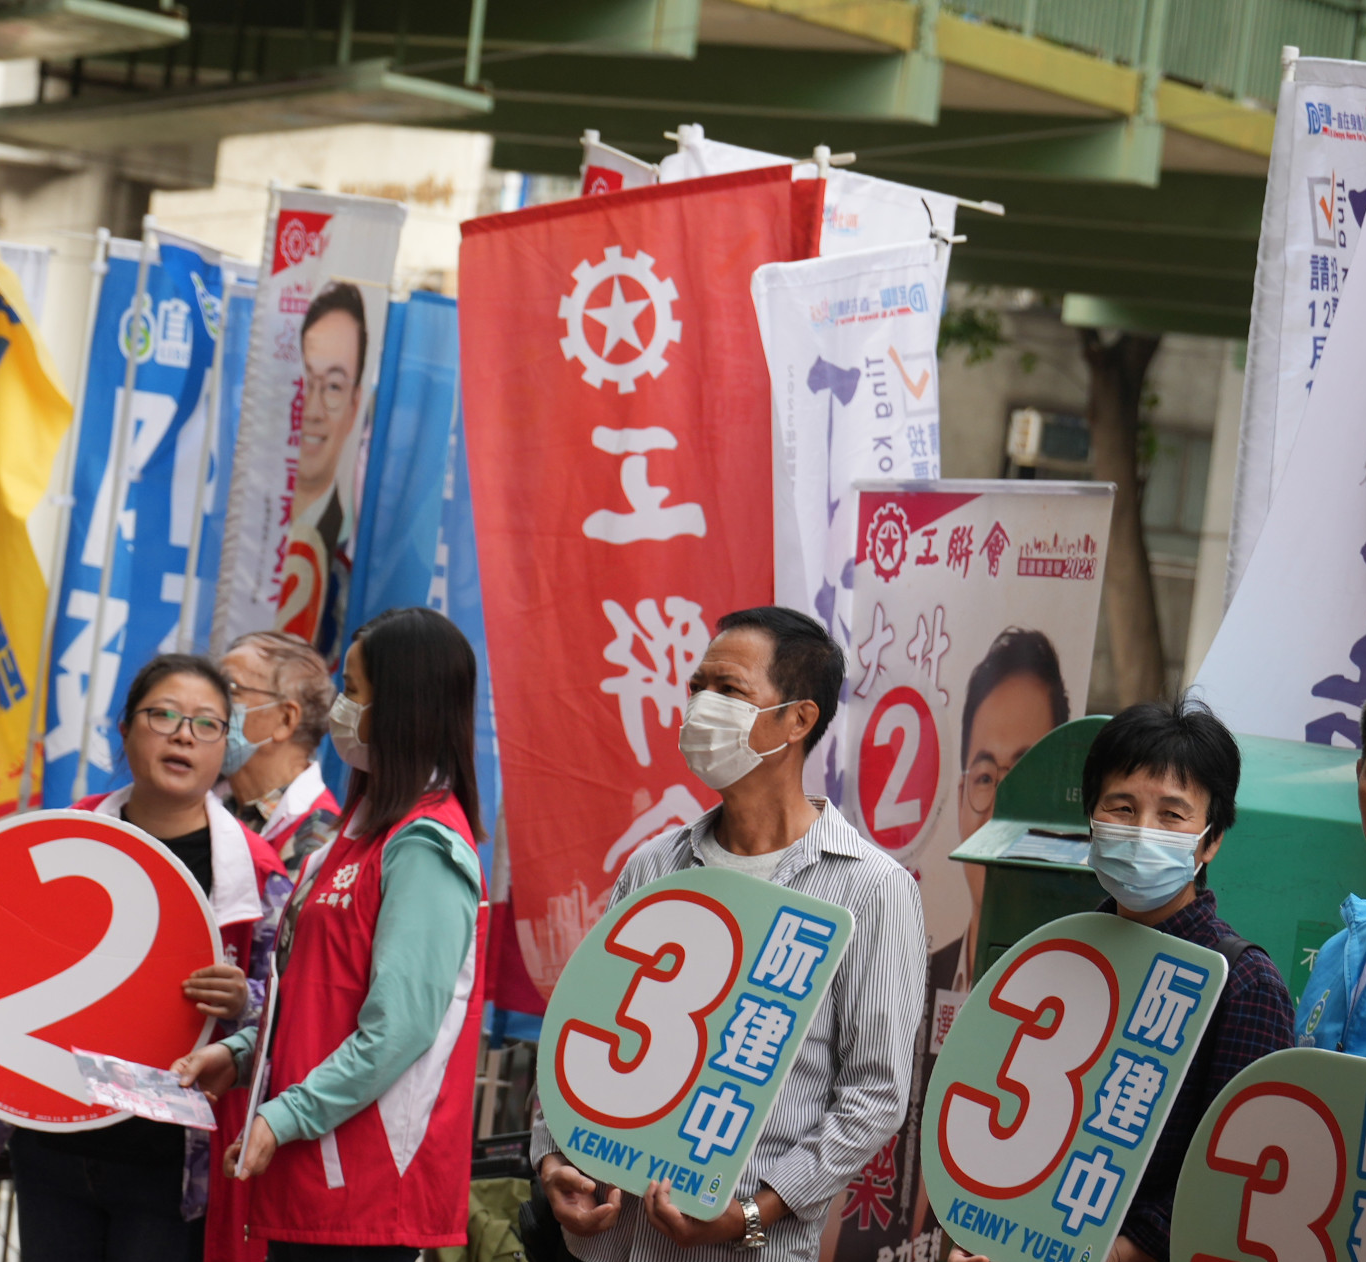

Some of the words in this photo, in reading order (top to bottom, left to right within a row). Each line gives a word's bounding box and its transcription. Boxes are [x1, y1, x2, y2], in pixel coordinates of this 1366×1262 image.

[914, 519, 1011, 580] 工聯會
[874, 701, 923, 832] 2
[554, 888, 744, 1130] 3
[678, 906, 837, 1165] 阮建中
[937, 937, 1120, 1201] 3
[1051, 952, 1210, 1238] 阮建中
[566, 1126, 643, 1172] KENNY
[647, 1155, 705, 1198] YUEN
[946, 1197, 1020, 1246] KENNY
